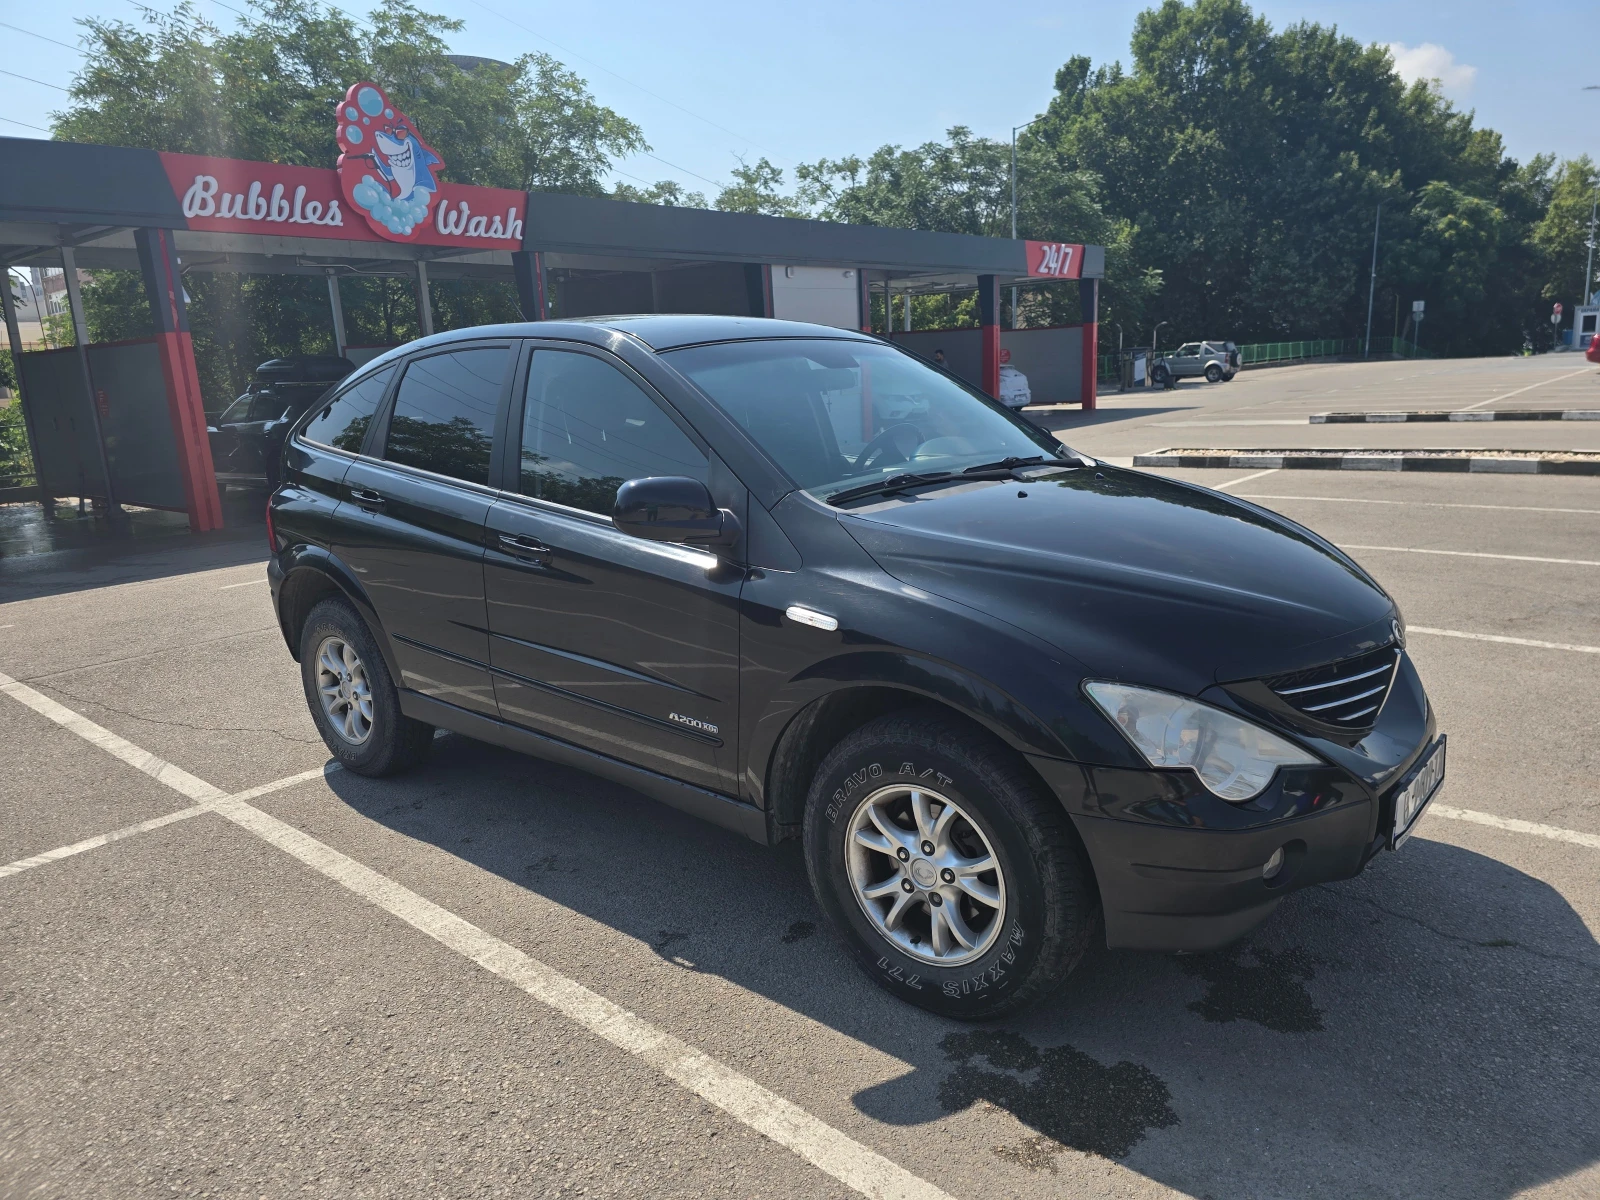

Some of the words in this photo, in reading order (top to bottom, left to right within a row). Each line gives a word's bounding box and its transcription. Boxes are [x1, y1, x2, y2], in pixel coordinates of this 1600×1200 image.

[183, 175, 343, 227] Bubbles
[436, 200, 523, 240] Wash
[1038, 244, 1073, 276] 24/7
[824, 763, 883, 823] BRAVO
[899, 762, 953, 787] A/T
[877, 957, 923, 990] 771
[942, 919, 1025, 999] MAXXIS
